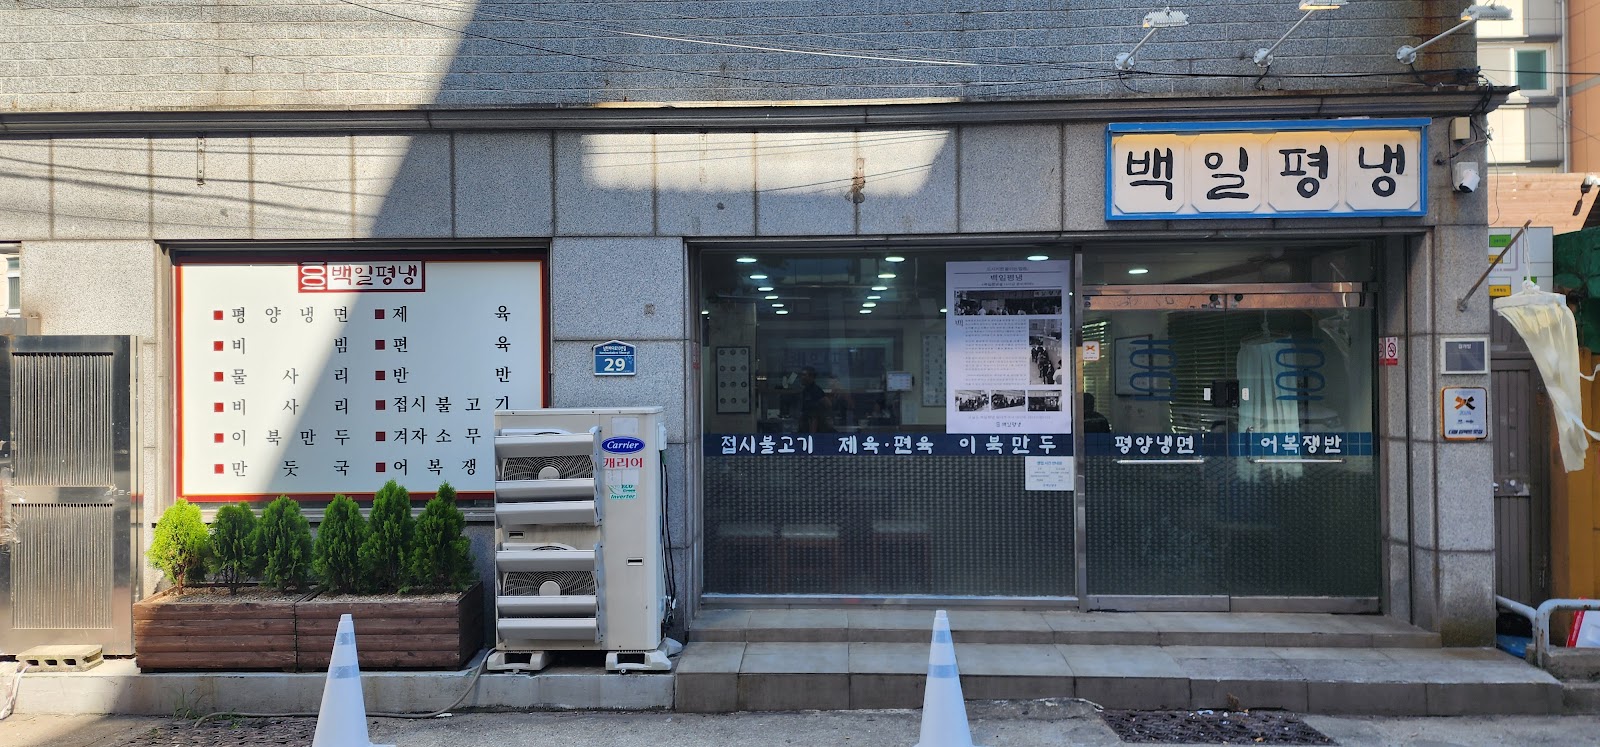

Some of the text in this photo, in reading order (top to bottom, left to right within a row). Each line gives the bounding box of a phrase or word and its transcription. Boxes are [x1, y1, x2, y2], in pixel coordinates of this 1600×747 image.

[1126, 143, 1406, 201] 백일평냉
[332, 264, 418, 286] 백일평냉
[231, 306, 349, 324] 평양냉면
[603, 357, 626, 372] 29
[393, 395, 509, 413] 접시불고기
[231, 429, 350, 447] 이북만두
[393, 427, 482, 445] 겨자소무
[606, 440, 640, 450] Carrier
[721, 435, 814, 455] 접시불고기
[959, 435, 1057, 455] 이북만두
[1114, 435, 1195, 454] 평양냉면
[1260, 435, 1342, 454] 어복쟁반
[393, 458, 476, 476] 어복쟁
[603, 456, 643, 469] 캐리어
